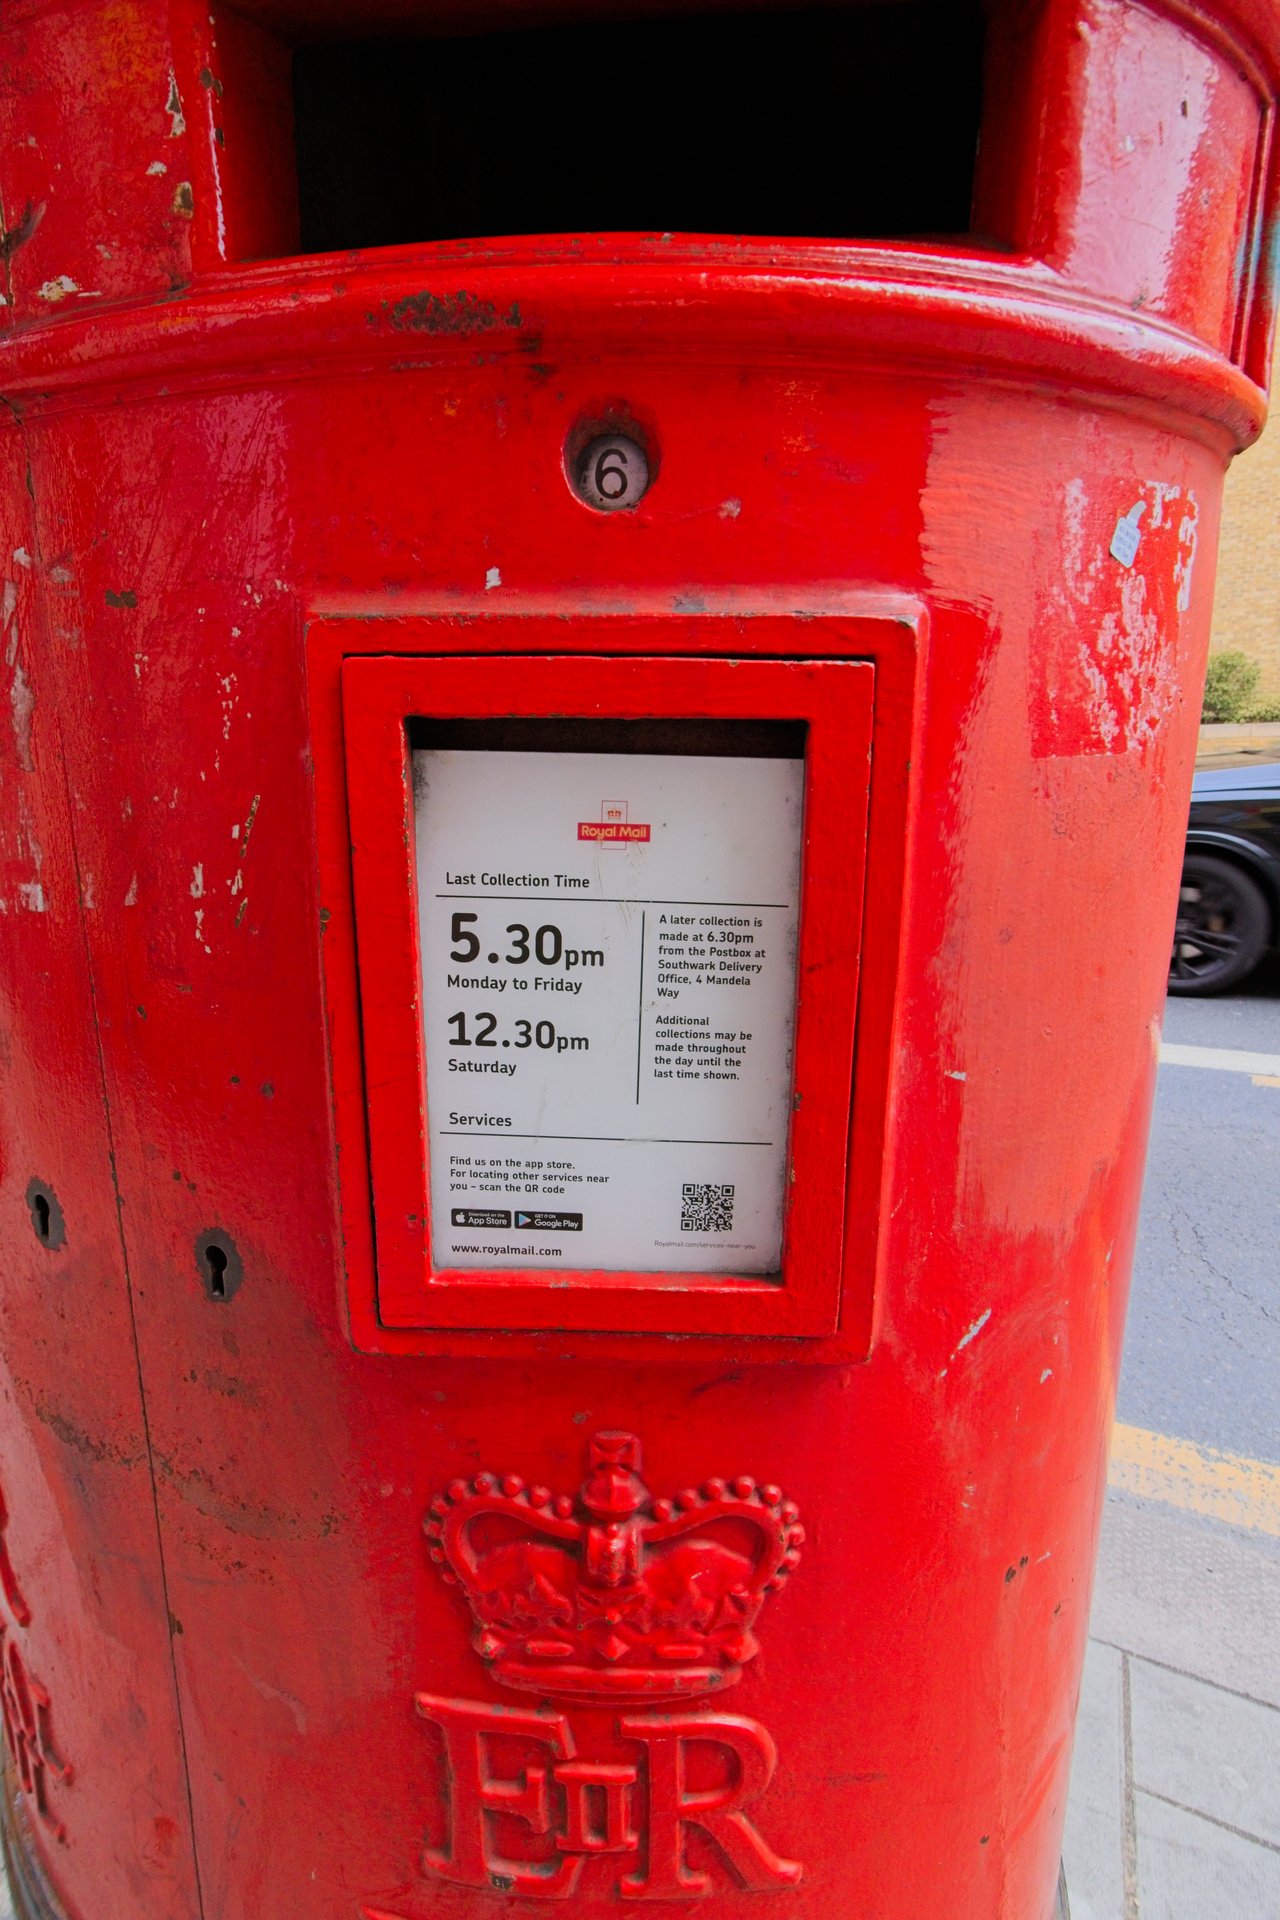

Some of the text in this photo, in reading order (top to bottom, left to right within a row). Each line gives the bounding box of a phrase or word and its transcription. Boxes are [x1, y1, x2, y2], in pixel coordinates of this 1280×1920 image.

[595, 448, 628, 499] 6
[581, 825, 646, 839] Royal Mail
[446, 872, 590, 888] Last Collection Time
[659, 914, 763, 927] A later collection is
[450, 912, 604, 971] 5.30pm
[659, 931, 754, 945] made at 6.30pm
[658, 945, 766, 958] from the Postbox at
[658, 959, 762, 974] Southwark Delivery
[447, 974, 582, 995] Monday to Friday
[657, 973, 751, 986] Office, 4 Mandela
[657, 987, 679, 999] Way
[655, 1015, 709, 1026] Additional
[448, 1011, 589, 1053] 12.30pm
[655, 1029, 753, 1041] collections may be
[655, 1043, 746, 1055] made throughout
[448, 1058, 517, 1076] Saturday
[654, 1056, 742, 1067] the day until the
[654, 1069, 740, 1080] last time shown.
[449, 1112, 512, 1127] Services
[450, 1156, 471, 1166] Find
[489, 1159, 501, 1167] on
[505, 1158, 522, 1168] the
[525, 1161, 544, 1170] app
[546, 1161, 576, 1170] store.
[450, 1168, 610, 1183] For locating other services near
[449, 1183, 468, 1192] you
[505, 1183, 521, 1192] the
[524, 1184, 539, 1193] QR
[542, 1185, 565, 1194] code
[468, 1217, 508, 1225] App Store
[534, 1219, 579, 1229] Google Play
[451, 1244, 562, 1256] www.royalmail.com
